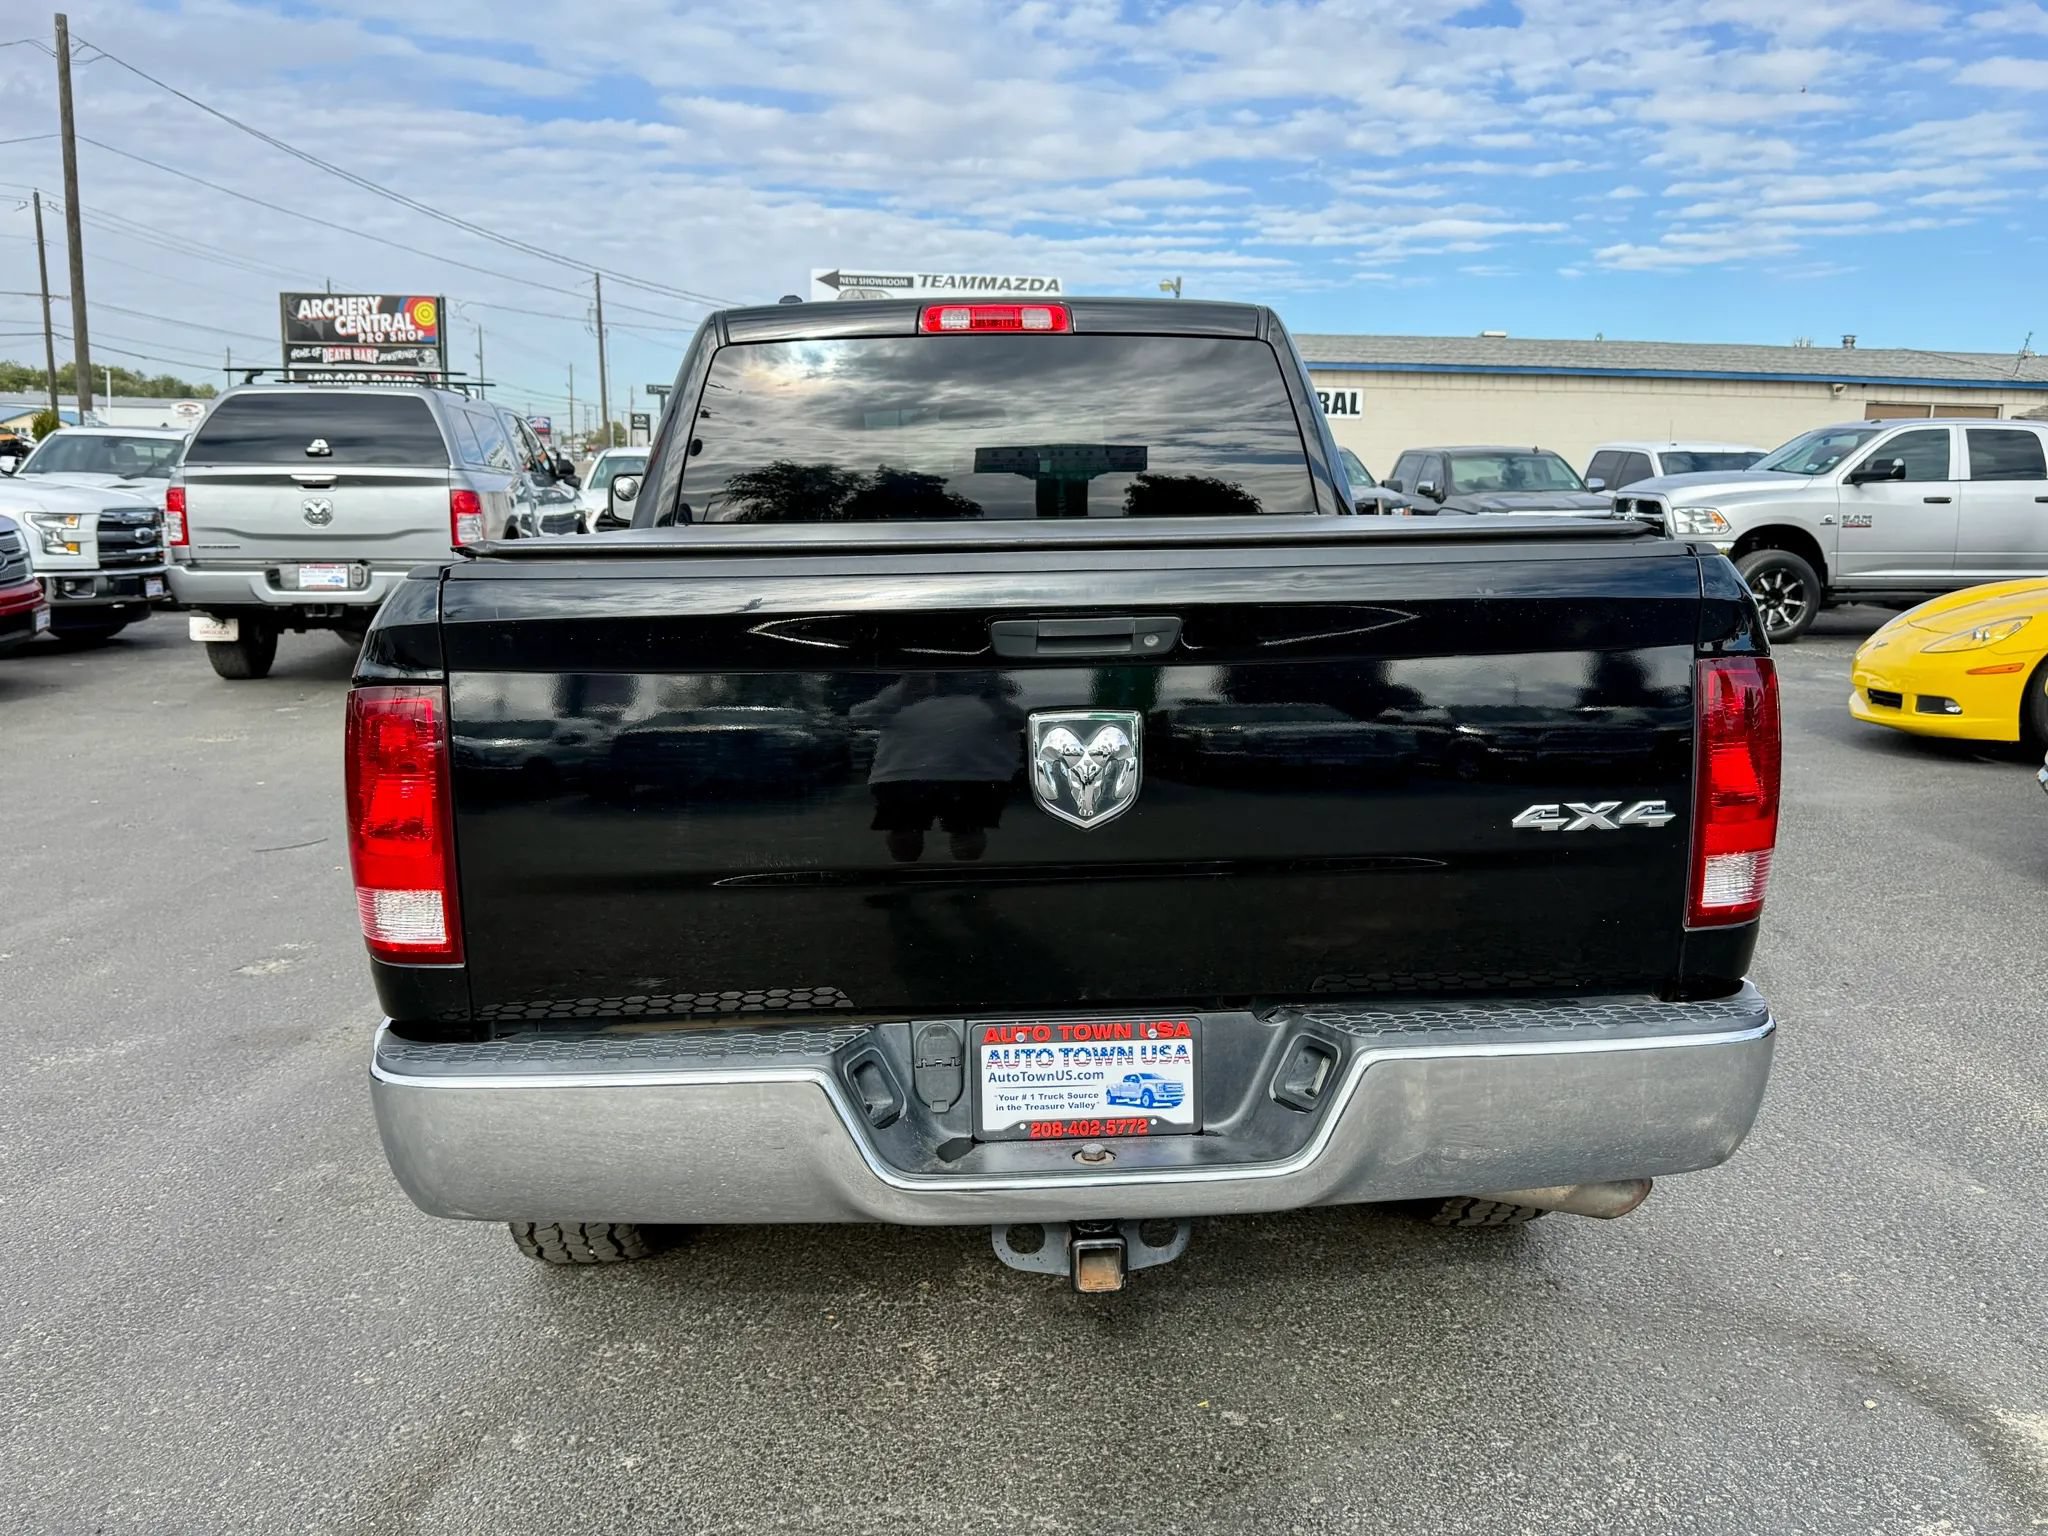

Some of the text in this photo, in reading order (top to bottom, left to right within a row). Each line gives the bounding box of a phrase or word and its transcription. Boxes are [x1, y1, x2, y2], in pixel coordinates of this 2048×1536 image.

[840, 276, 908, 286] NEW SHOWROOM
[918, 274, 1060, 292] TEAMMAZDA
[297, 296, 382, 320] ARCHERY
[334, 312, 416, 336] CENTRAL
[358, 330, 425, 343] PRO SHOP
[322, 347, 352, 363] DEATH
[982, 1021, 1192, 1043] AUTO TOWN USA
[985, 1044, 1191, 1070] AUTO TOWN USA
[987, 1070, 1105, 1084] AutoTownUS.com
[1021, 1093, 1028, 1101] #
[1030, 1093, 1036, 1101] 1
[1038, 1092, 1065, 1101] Truck
[1067, 1091, 1100, 1100] Source
[995, 1103, 1005, 1112] in
[1007, 1103, 1023, 1112] the
[1025, 1103, 1066, 1111] Treasure
[1029, 1118, 1149, 1138] 208-402-5772
